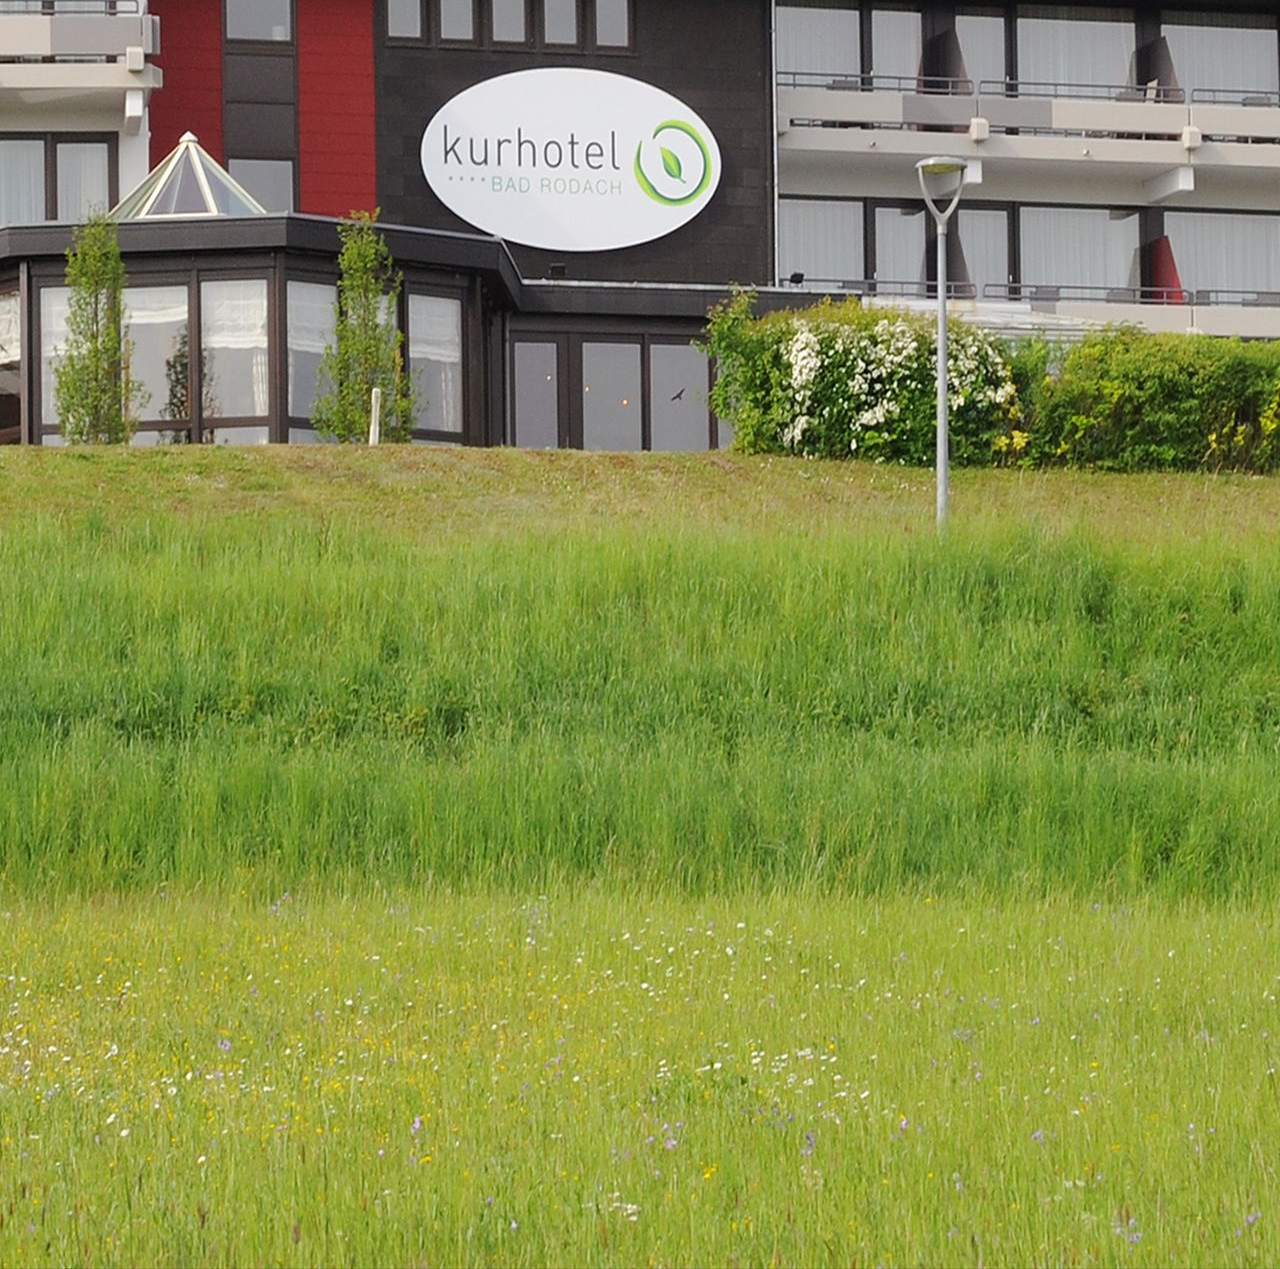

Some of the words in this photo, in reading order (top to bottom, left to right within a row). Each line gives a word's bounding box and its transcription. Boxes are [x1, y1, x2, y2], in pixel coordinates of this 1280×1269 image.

[443, 125, 621, 171] kurhotel
[491, 176, 531, 194] BAD
[540, 178, 622, 196] RODACH
